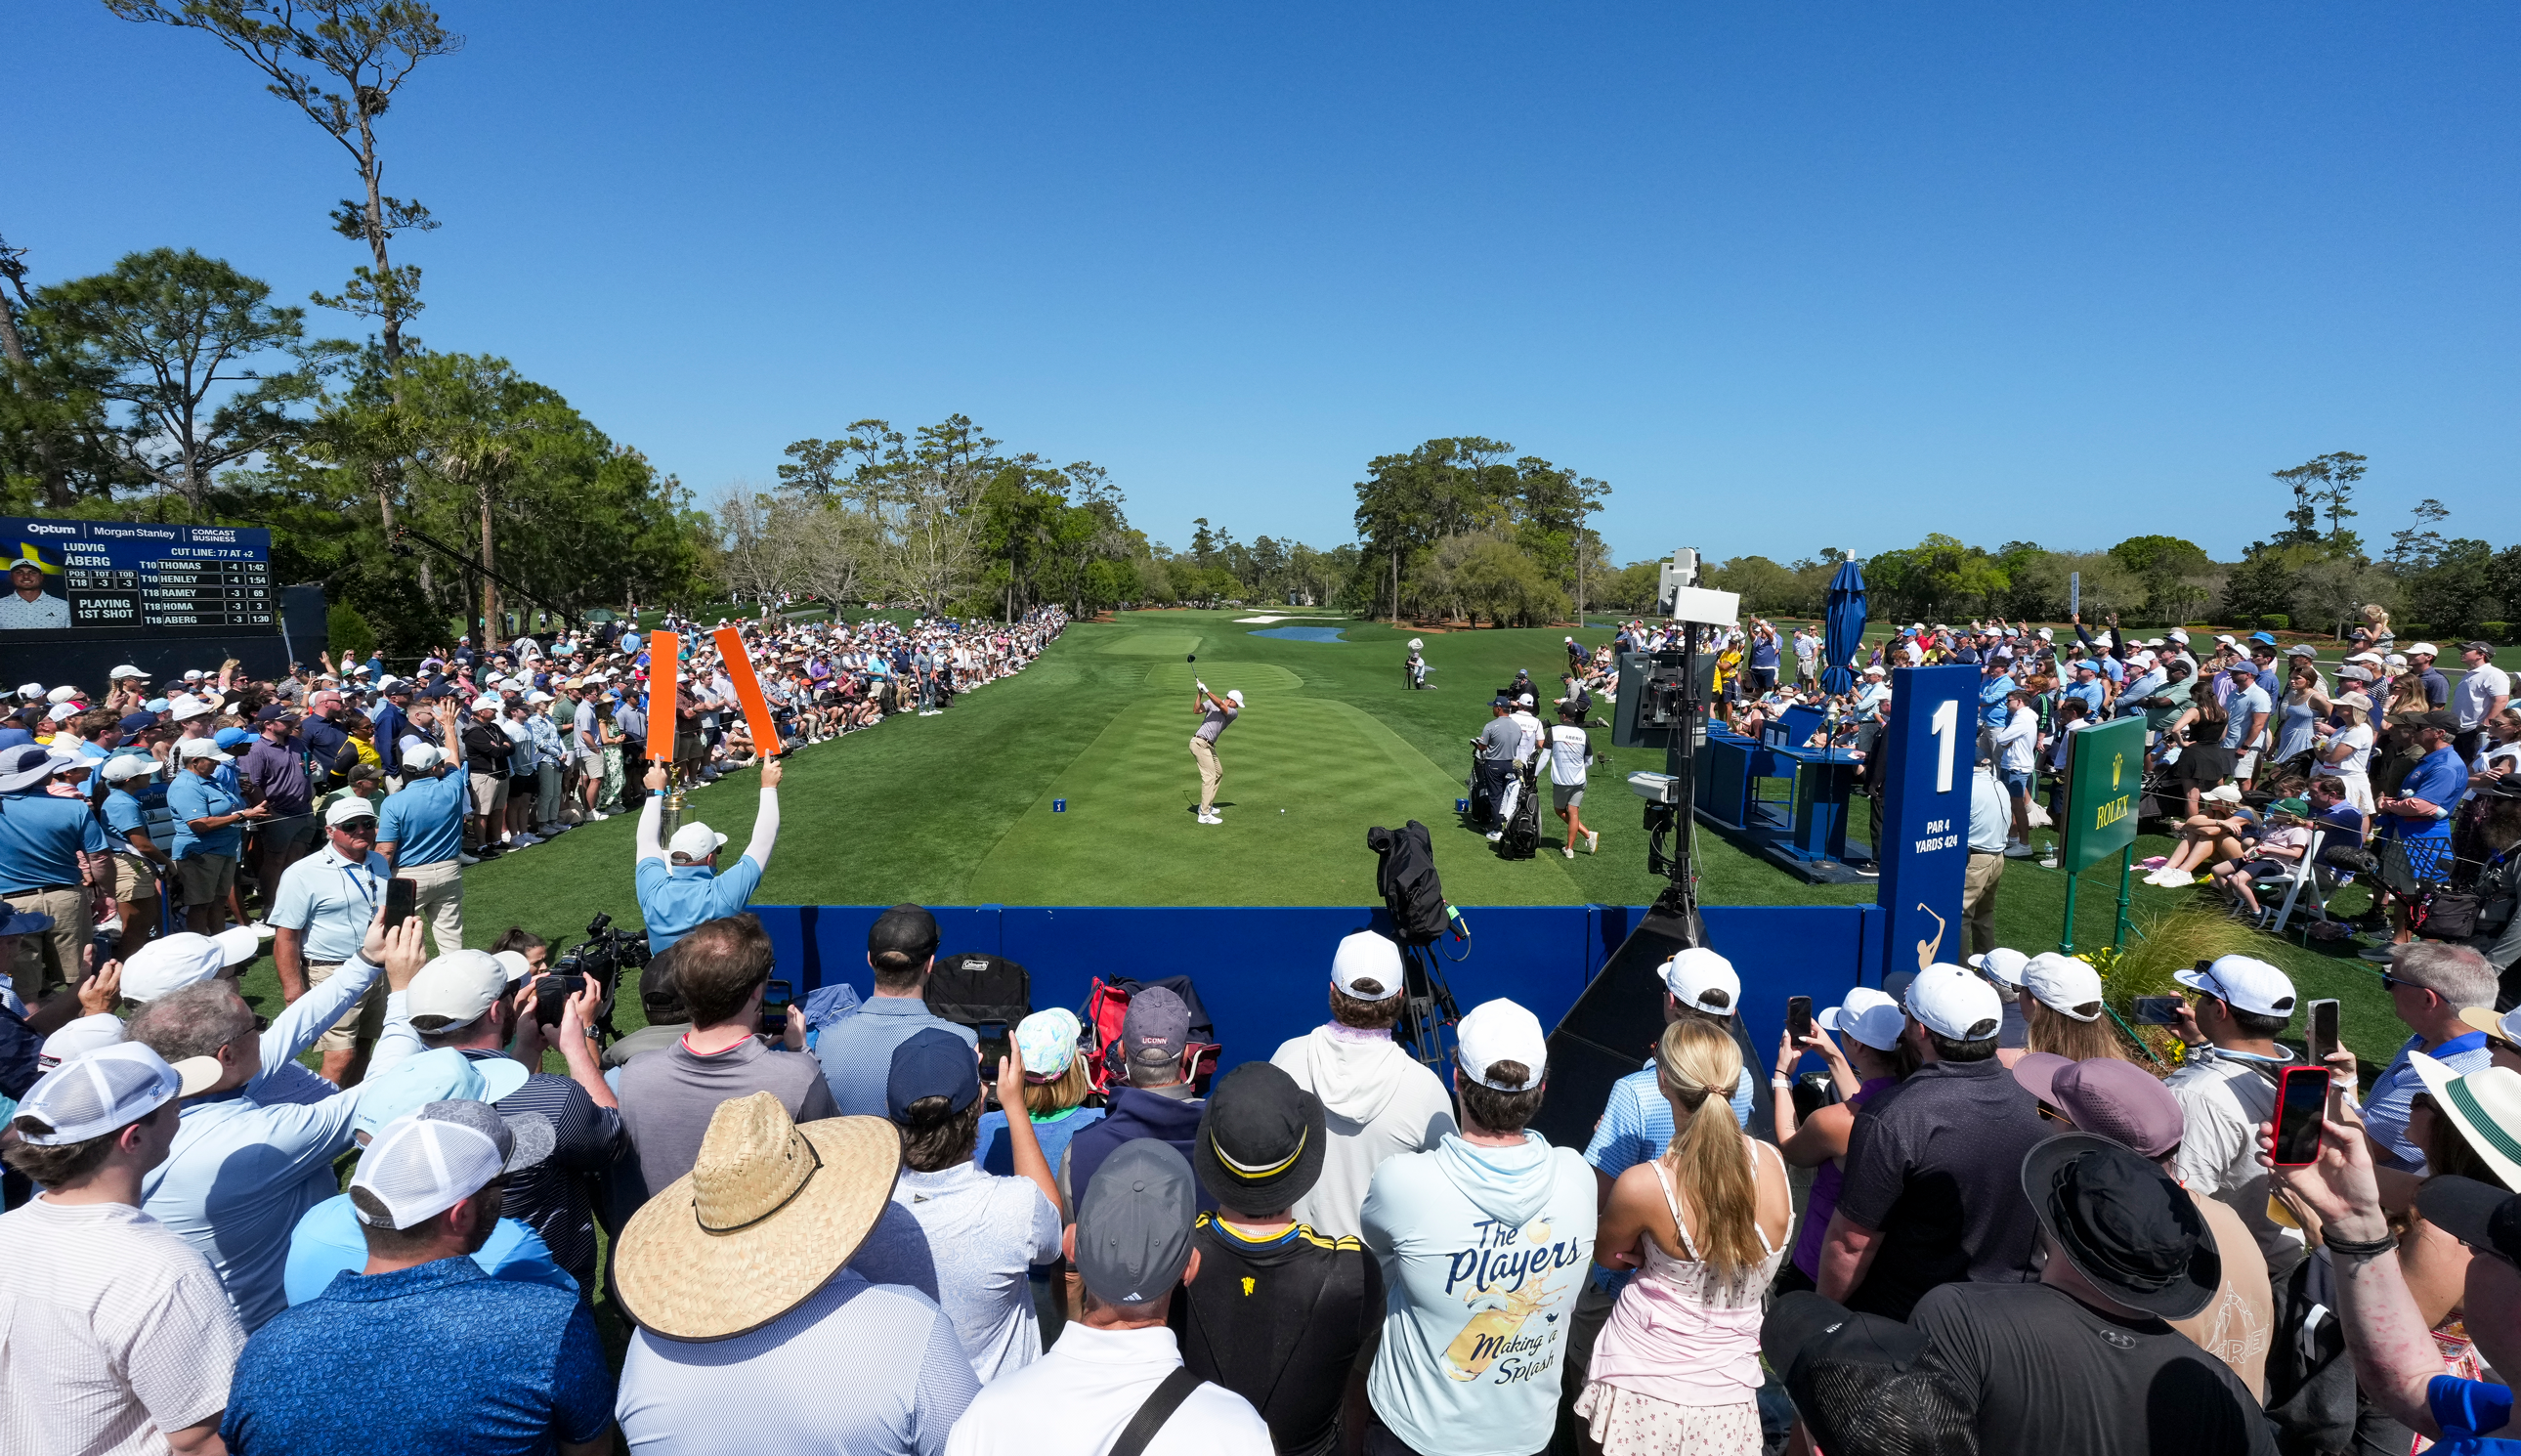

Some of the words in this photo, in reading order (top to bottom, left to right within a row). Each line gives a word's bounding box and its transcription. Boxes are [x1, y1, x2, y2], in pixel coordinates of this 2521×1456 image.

[27, 524, 76, 535] Optum
[94, 527, 135, 537] Morgan
[137, 529, 175, 539] Stanley
[64, 542, 106, 552] LUDVIG
[192, 548, 216, 557] LINE:
[64, 553, 110, 566] ÅBERG
[140, 561, 156, 570] T10
[159, 561, 201, 570] THOMAS
[78, 610, 99, 619] 1ST
[103, 610, 134, 619] SHOT
[1932, 700, 1958, 793] 1
[2096, 794, 2129, 830] ROLEX
[1927, 820, 1944, 835] PAR
[1944, 819, 1950, 831] 4
[1915, 836, 1944, 853] YARDS
[1944, 835, 1958, 848] 424
[1474, 1219, 1518, 1249] The
[1445, 1237, 1582, 1296] Players
[1470, 1333, 1543, 1361] Making
[1548, 1330, 1558, 1343] a
[1494, 1350, 1554, 1385] Splash
